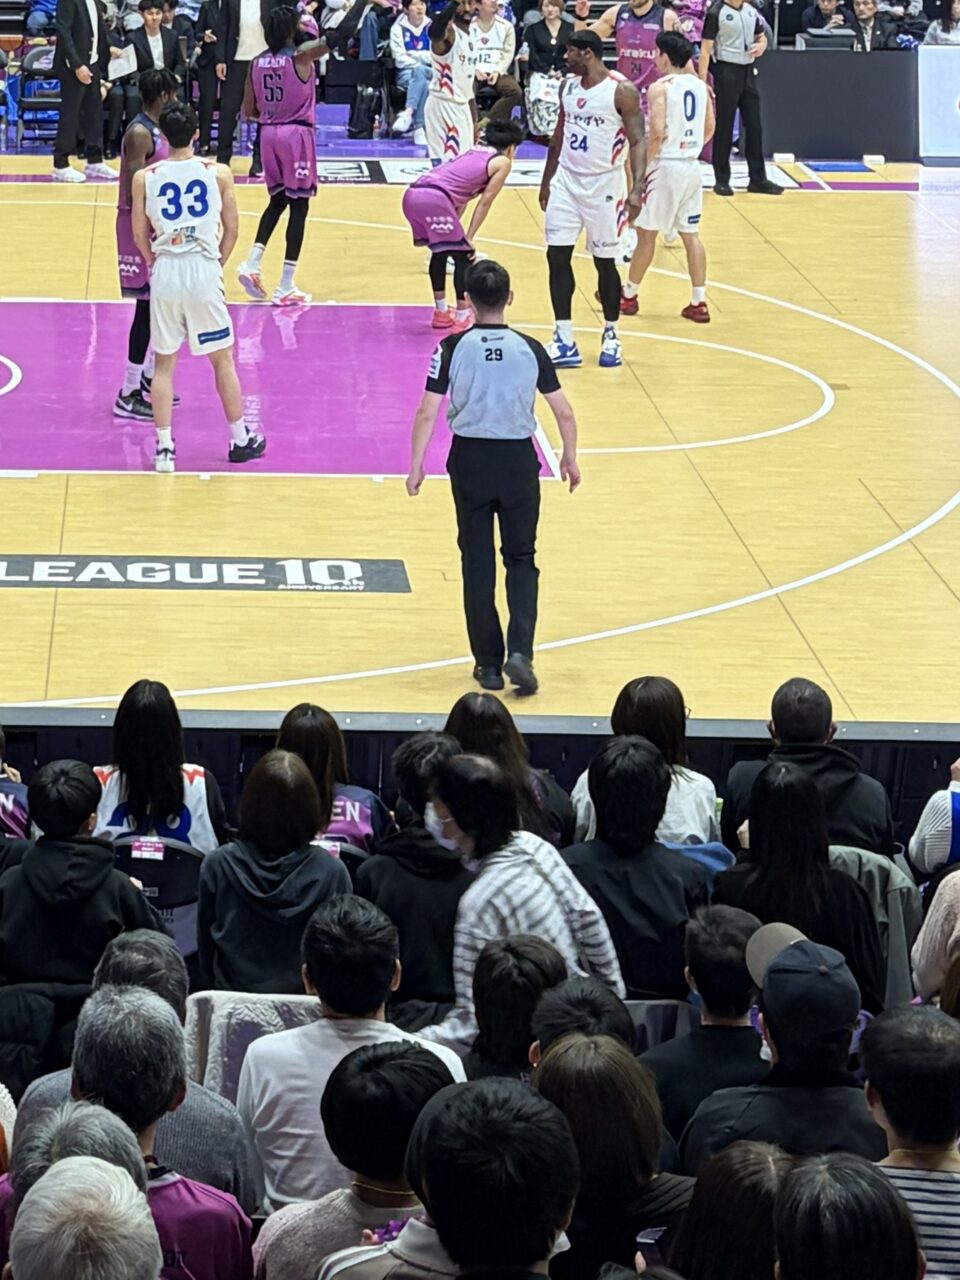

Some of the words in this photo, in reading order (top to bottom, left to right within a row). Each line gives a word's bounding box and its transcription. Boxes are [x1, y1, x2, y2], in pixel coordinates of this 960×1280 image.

[263, 73, 284, 102] 55
[683, 90, 696, 121] 0
[570, 133, 588, 152] 24
[157, 179, 209, 220] 33
[484, 348, 503, 361] 29
